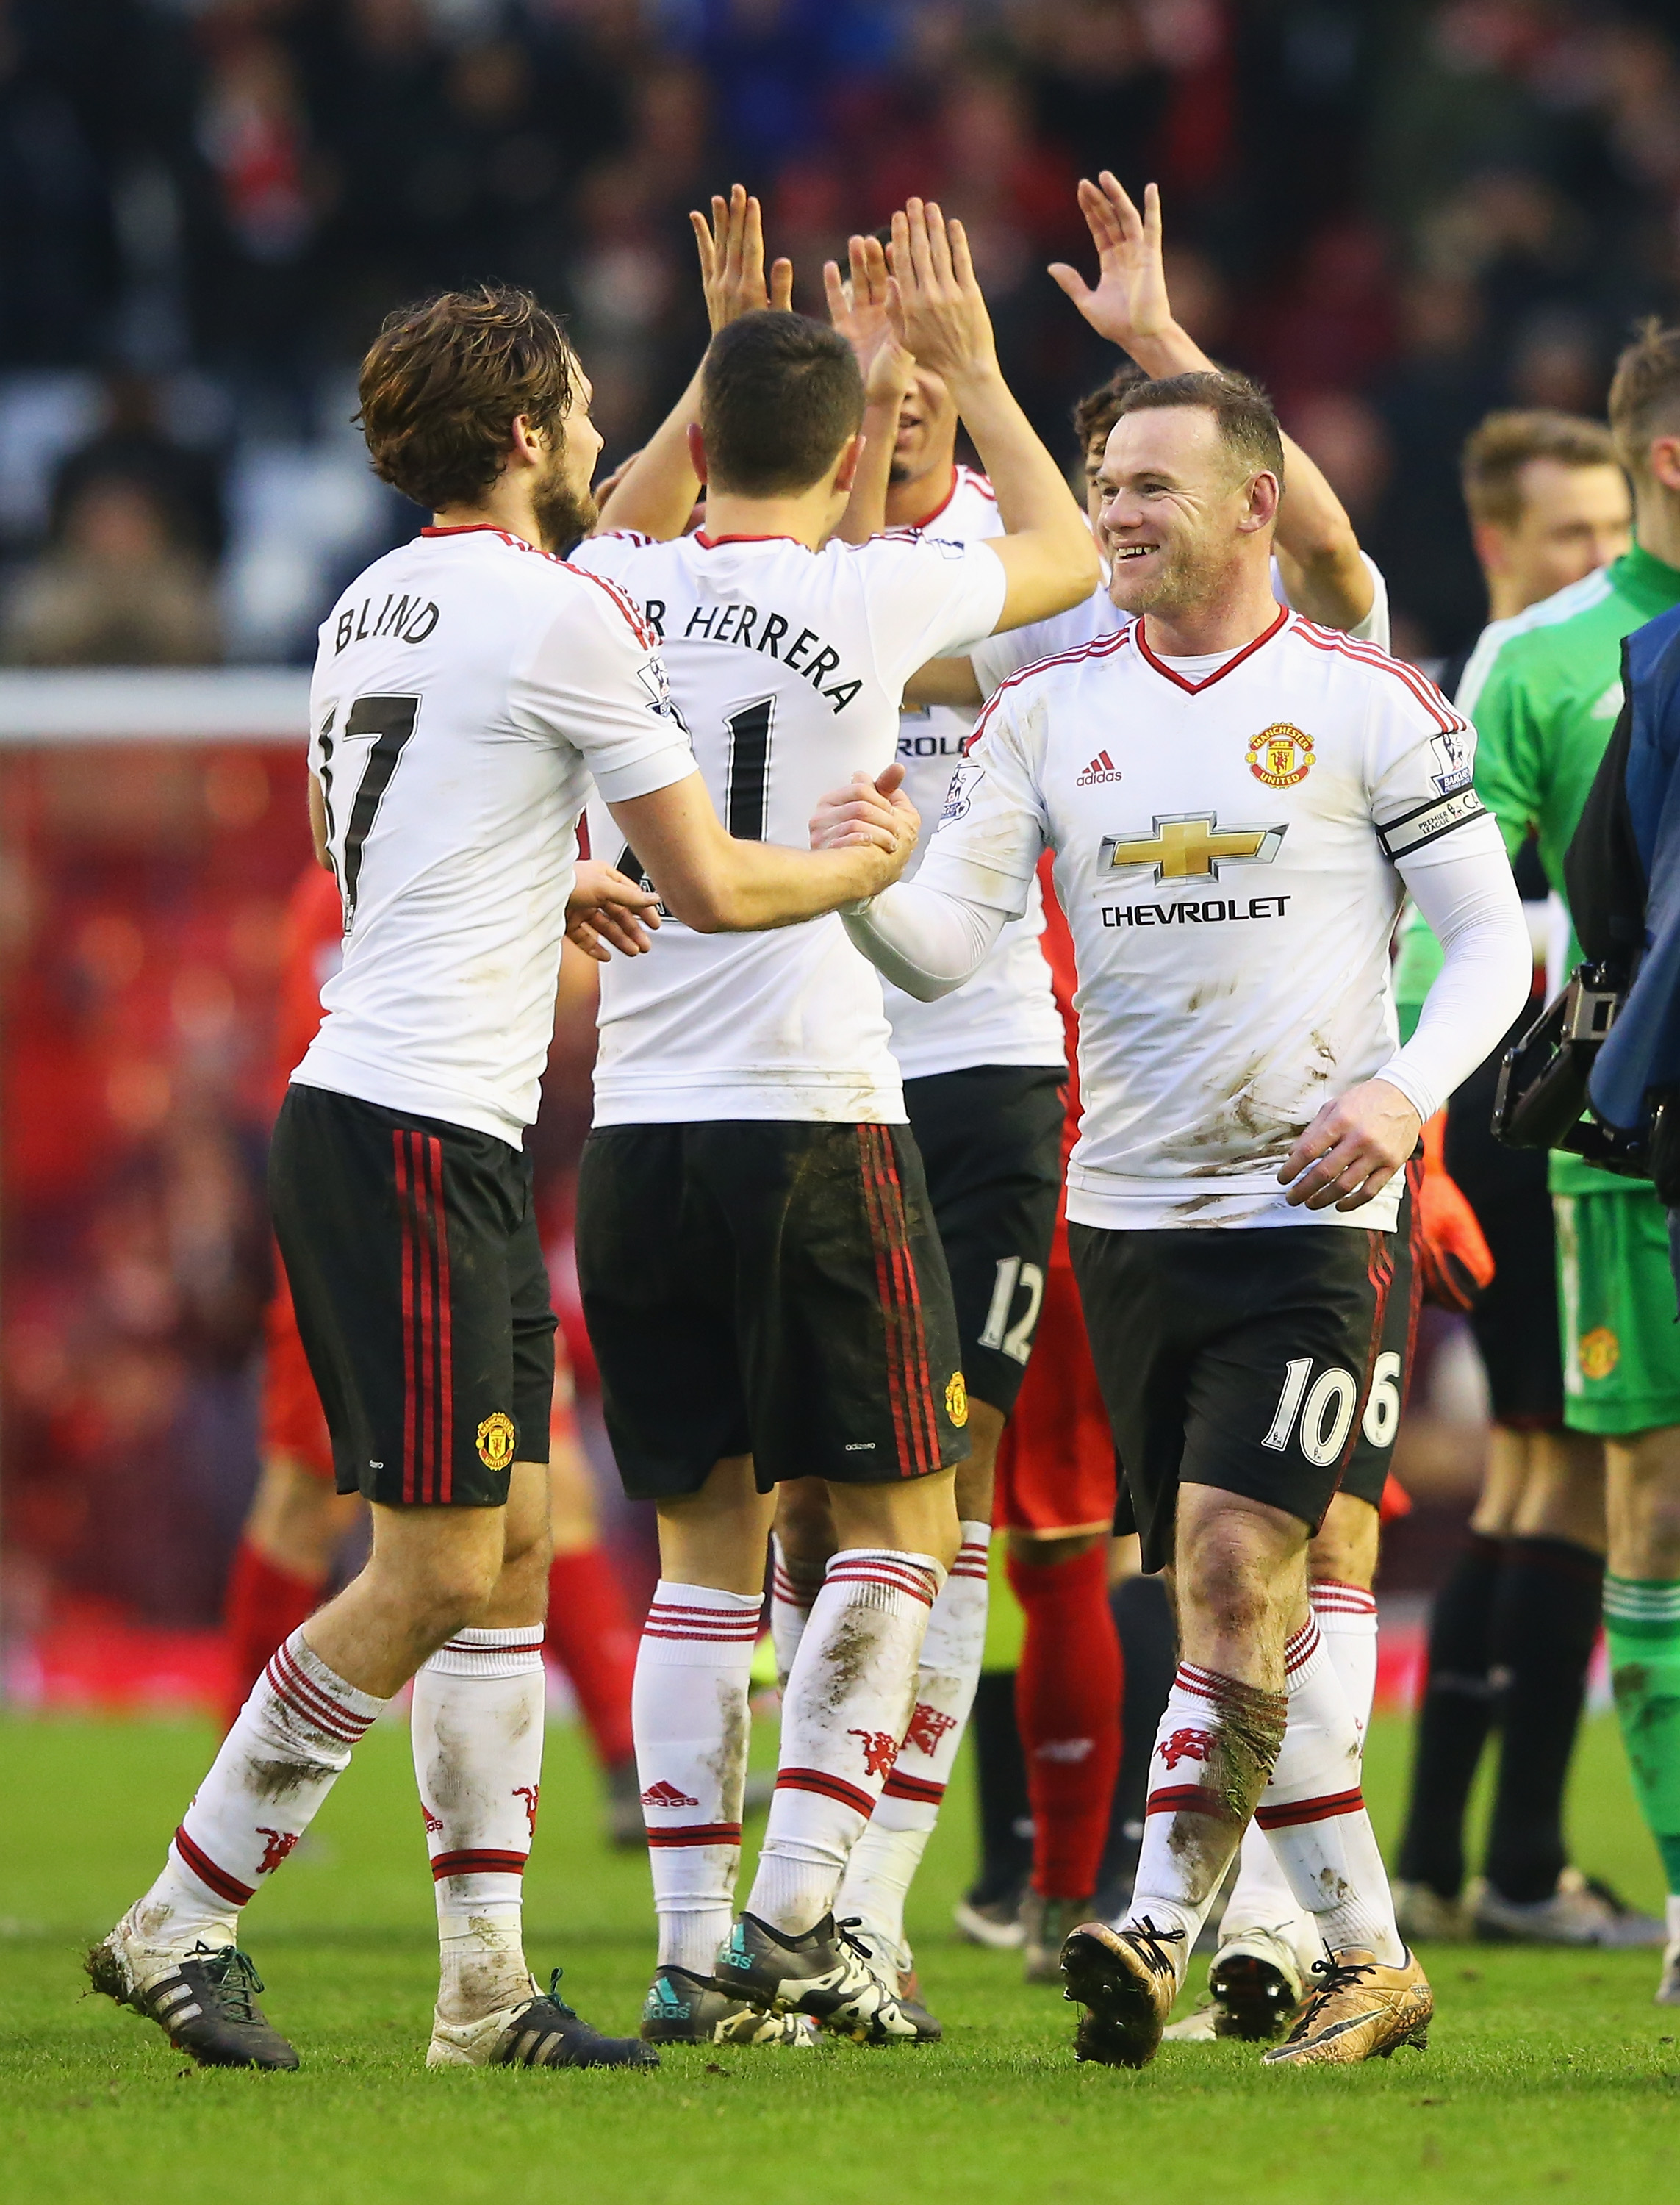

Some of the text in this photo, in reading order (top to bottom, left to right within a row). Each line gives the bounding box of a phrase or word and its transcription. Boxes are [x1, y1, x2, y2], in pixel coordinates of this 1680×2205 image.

[334, 593, 440, 657] BLIND
[683, 604, 865, 716] HERRERA
[1253, 725, 1310, 750] MANCHESTER
[1076, 770, 1122, 787] adidas
[1260, 772, 1300, 785] UNITED
[319, 692, 423, 937] 17
[1418, 811, 1449, 830] PREMIER
[1422, 817, 1450, 834] LEAGUE
[1102, 895, 1291, 928] CHEVROLET
[977, 1255, 1044, 1366] 12
[1260, 1358, 1357, 1467] 10
